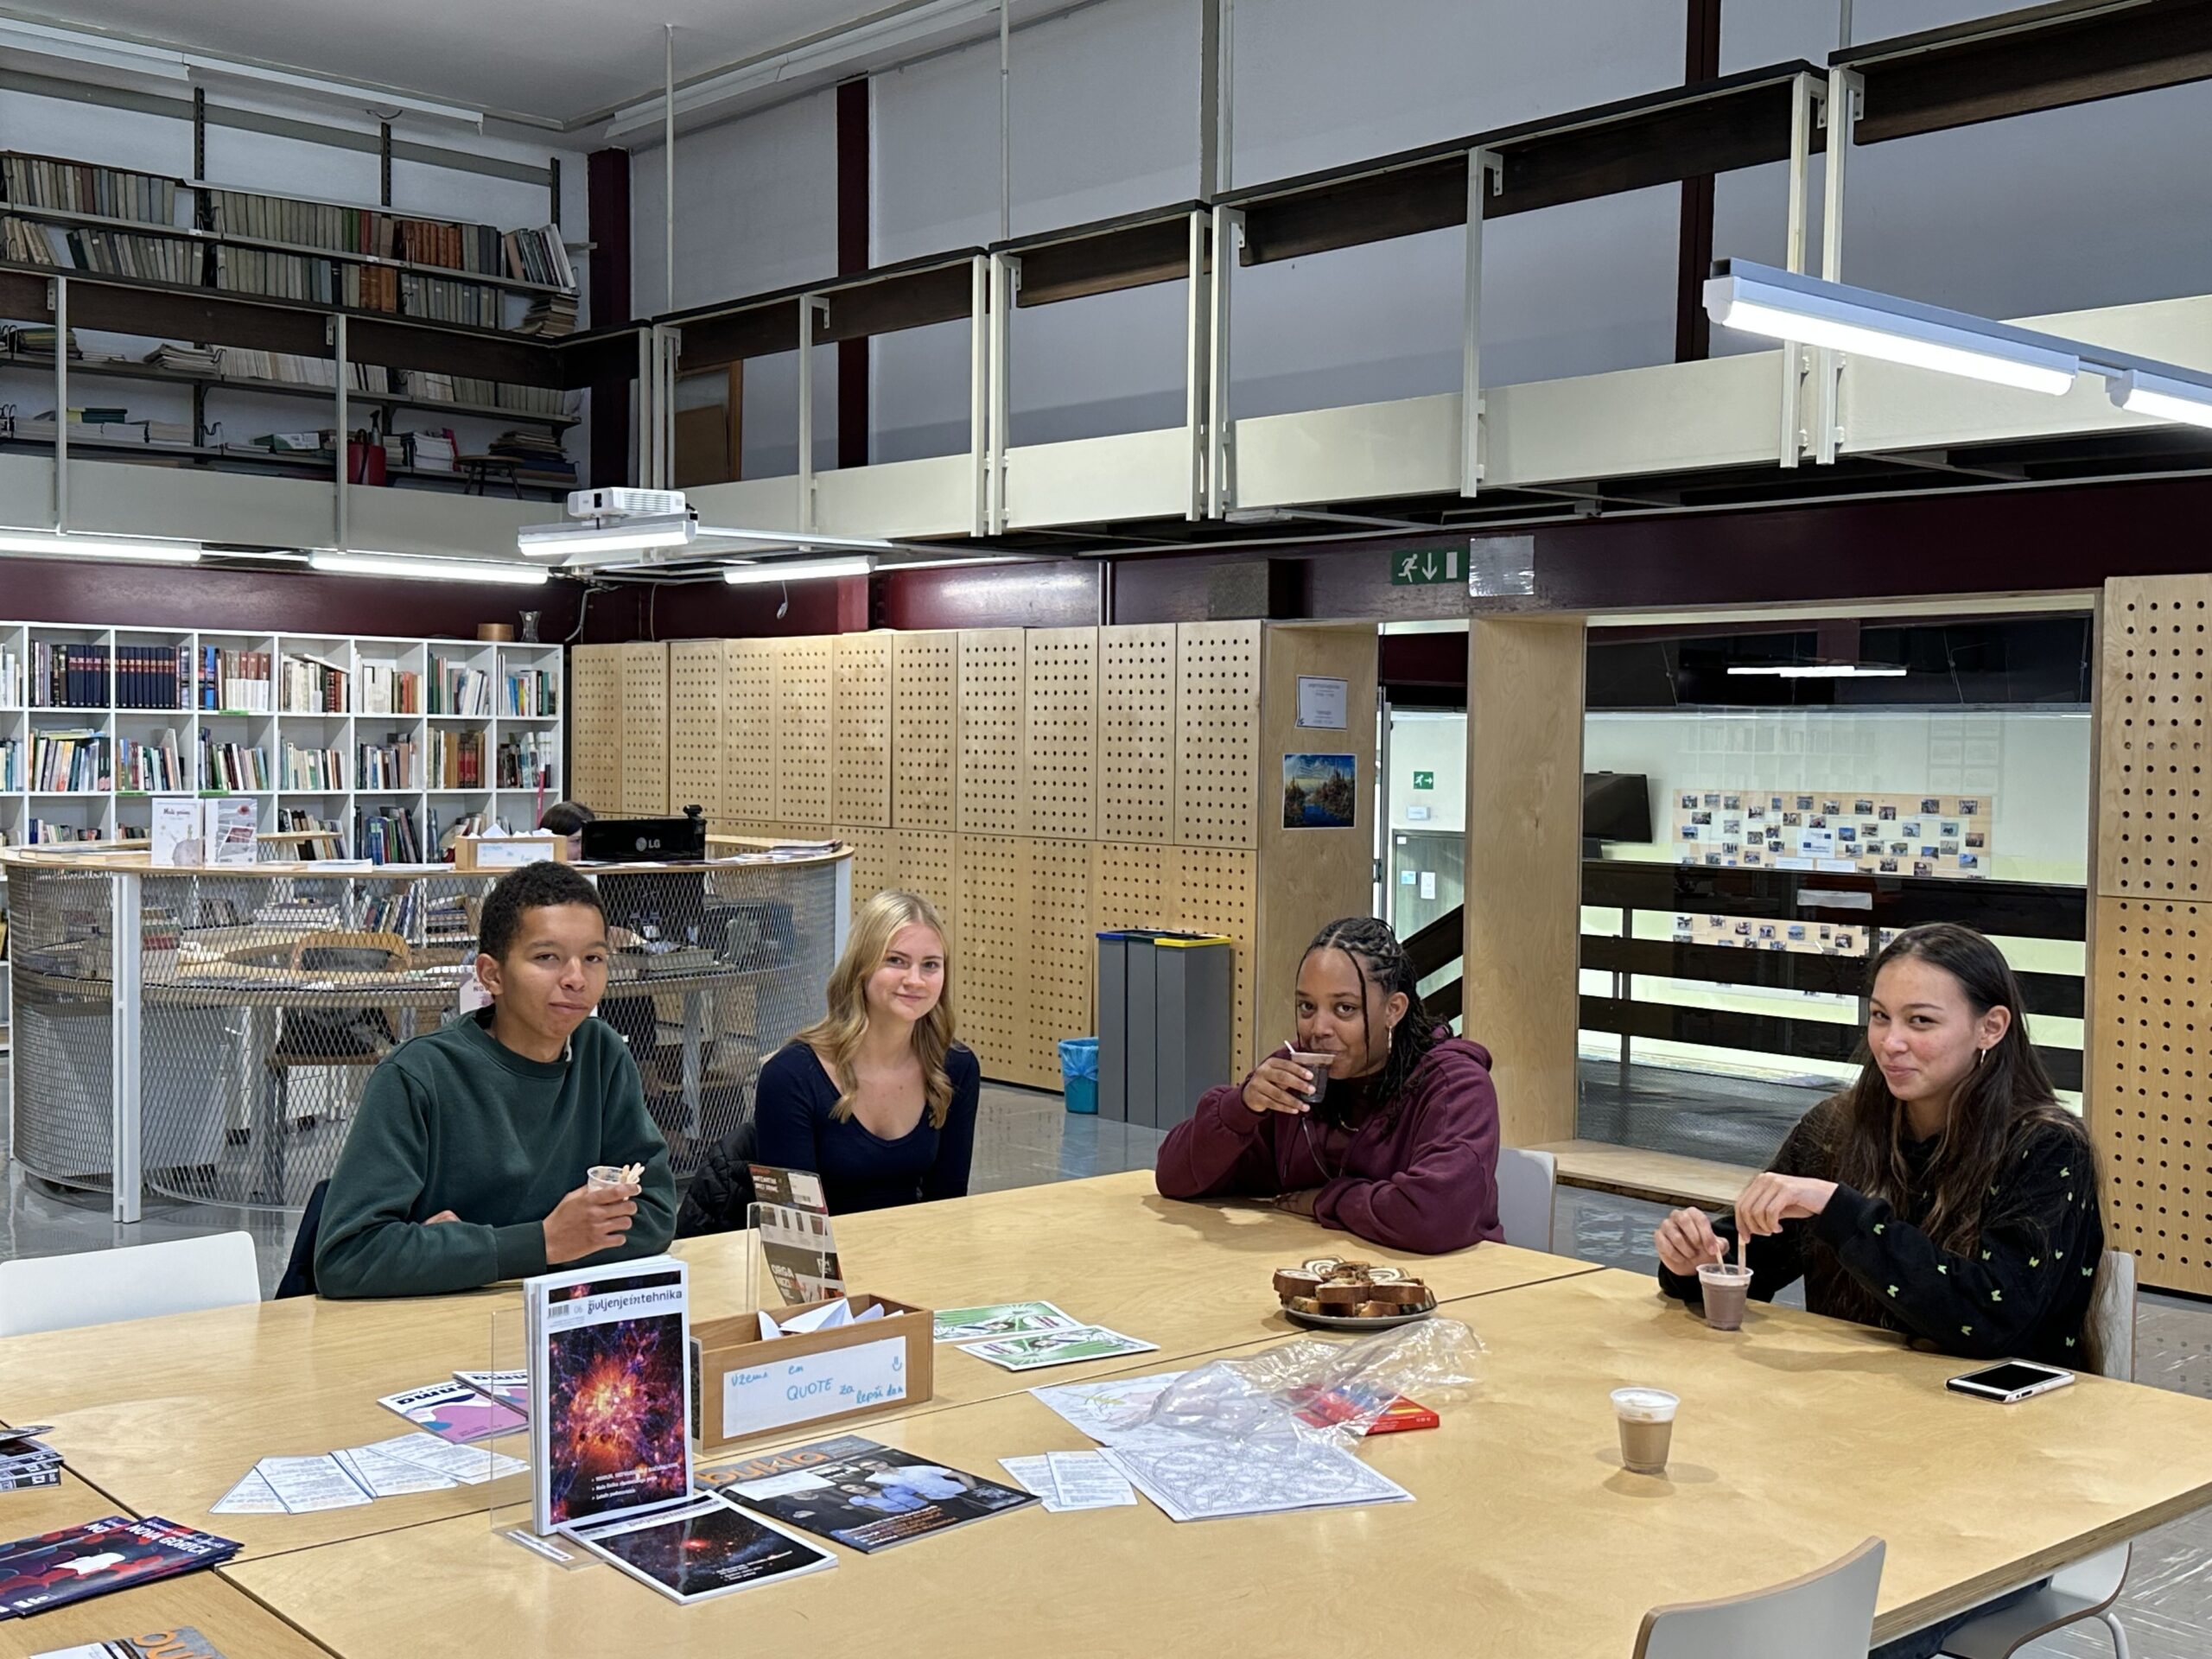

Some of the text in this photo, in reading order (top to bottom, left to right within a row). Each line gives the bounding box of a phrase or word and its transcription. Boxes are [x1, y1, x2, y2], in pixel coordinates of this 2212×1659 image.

[648, 838, 661, 849] LG
[786, 1378, 833, 1401] QUOTE
[84, 1522, 111, 1535] NO
[124, 1524, 165, 1541] NOVA
[158, 1536, 212, 1555] GORICA
